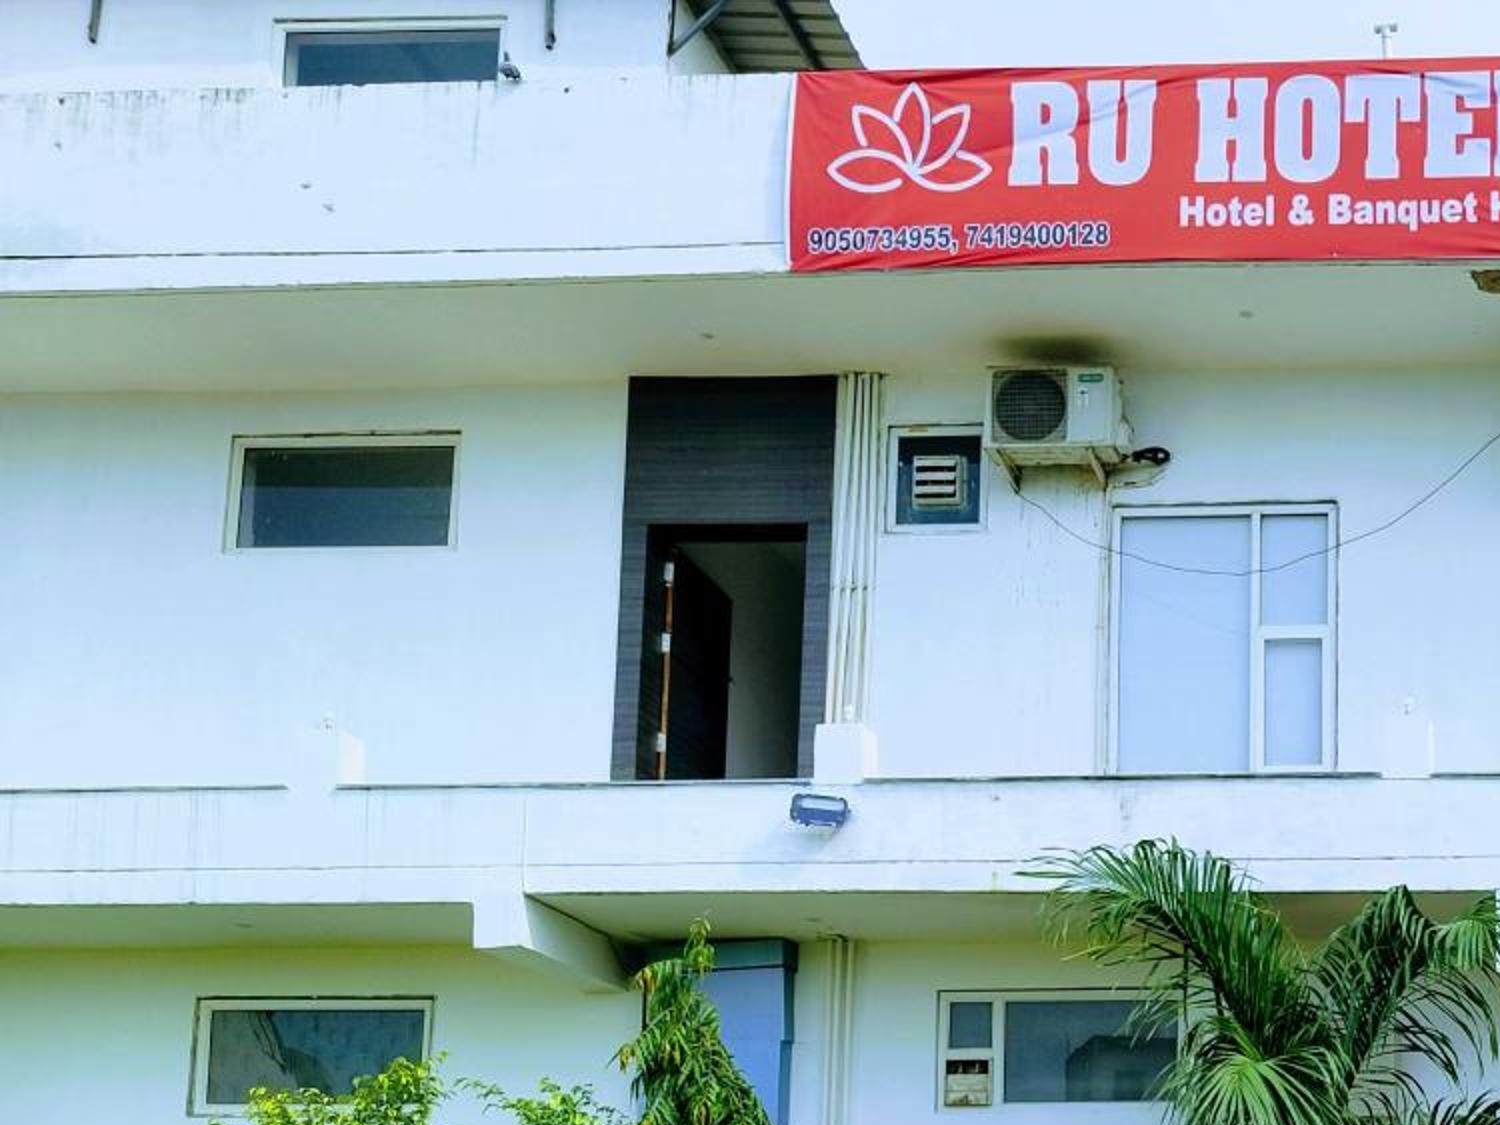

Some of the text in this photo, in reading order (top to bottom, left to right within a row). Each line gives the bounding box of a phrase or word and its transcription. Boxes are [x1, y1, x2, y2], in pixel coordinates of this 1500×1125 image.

[1007, 79, 1157, 187] RU
[1179, 194, 1275, 227] Hotel
[1287, 194, 1314, 226] &
[1327, 191, 1477, 232] Banquet
[807, 222, 1111, 255] 9050734955, 7419400128
